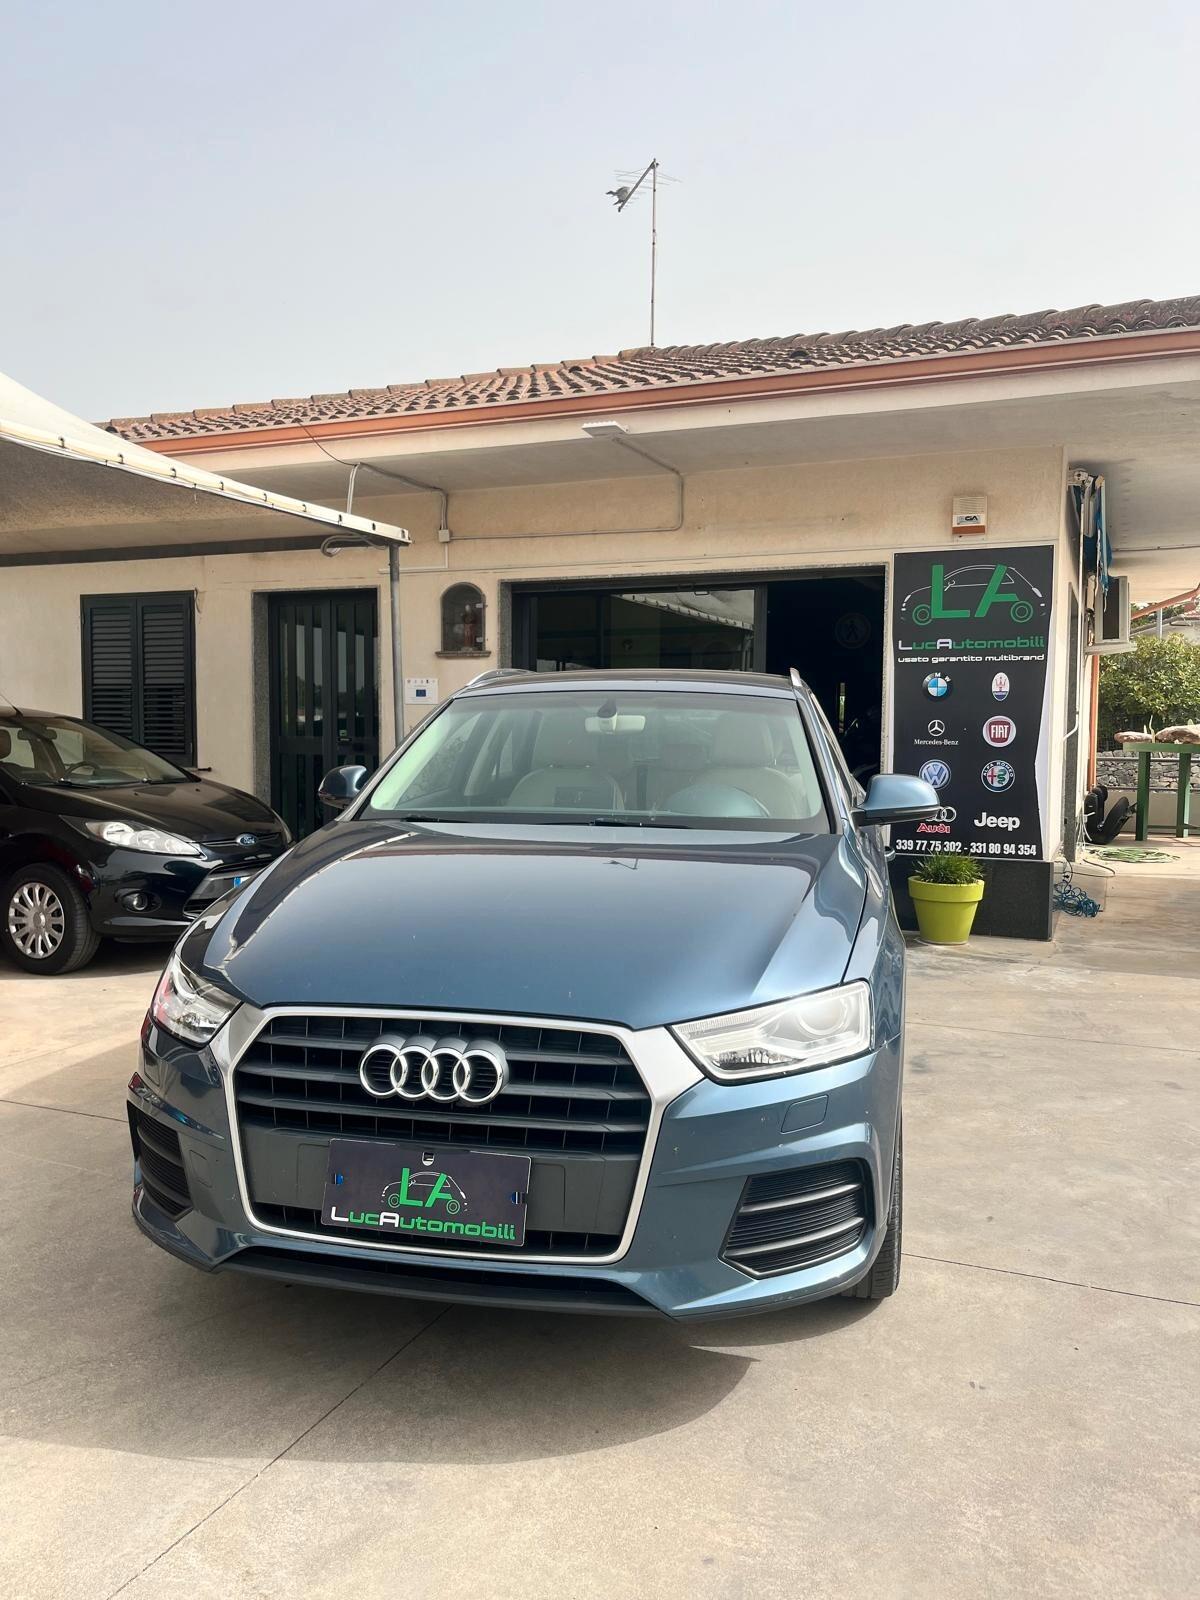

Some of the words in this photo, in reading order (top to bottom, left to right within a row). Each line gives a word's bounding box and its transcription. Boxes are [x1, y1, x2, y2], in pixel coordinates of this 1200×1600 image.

[898, 636, 1045, 650] LucAutomobili
[932, 655, 983, 664] garantito
[990, 725, 1009, 739] FIAT
[916, 822, 950, 833] Audi
[974, 812, 1020, 831] Jeep
[896, 840, 913, 850] 339
[915, 840, 927, 850] 77
[930, 841, 941, 851] 75
[943, 841, 961, 852] 302
[970, 843, 986, 854] 331
[988, 843, 1001, 854] 80
[1003, 844, 1015, 855] 94
[1018, 845, 1037, 856] 354
[330, 1206, 516, 1241] LucAutomobili
